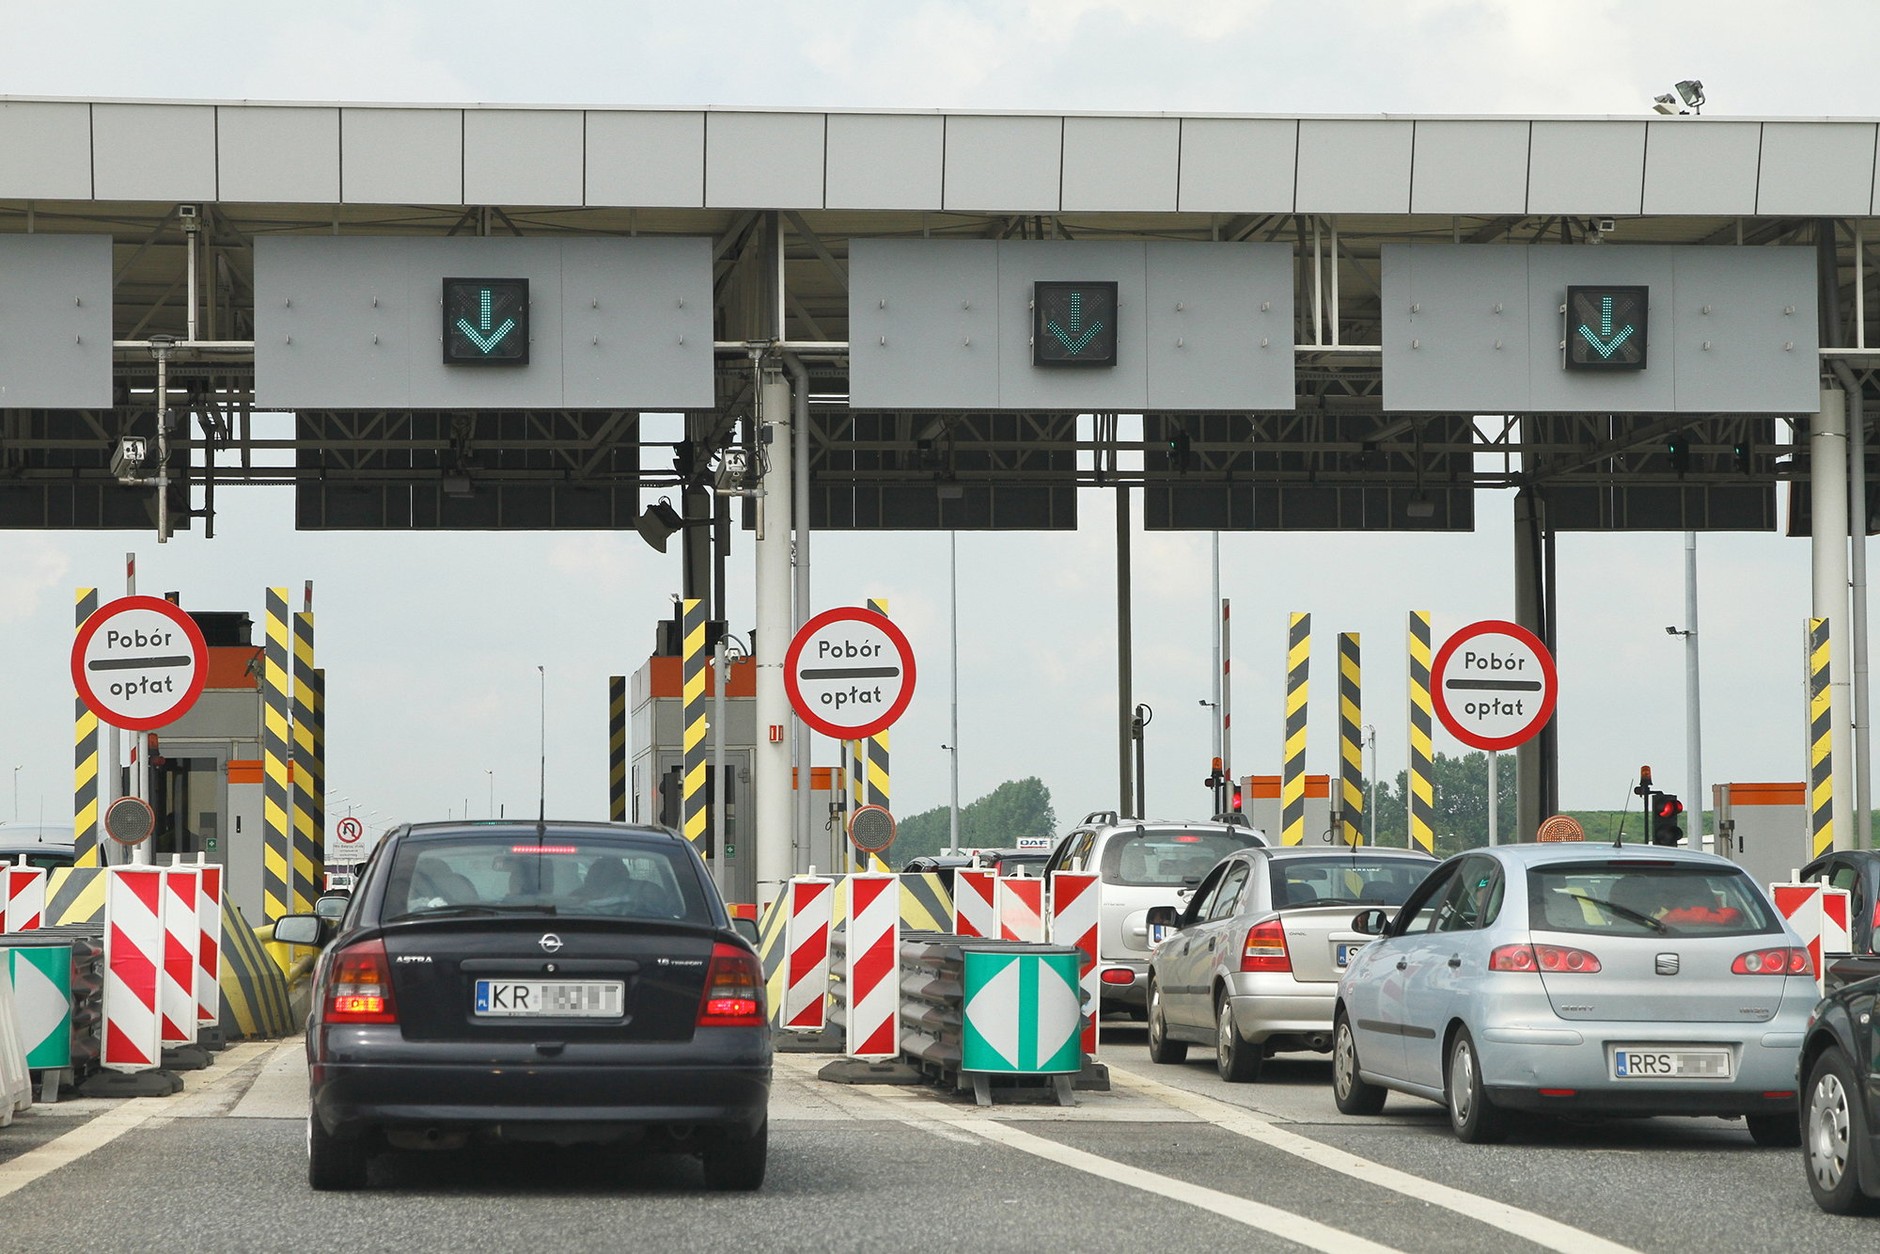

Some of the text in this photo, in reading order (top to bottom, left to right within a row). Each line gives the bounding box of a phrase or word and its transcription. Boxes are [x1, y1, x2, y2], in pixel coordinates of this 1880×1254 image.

[107, 628, 171, 649] Pobór
[819, 640, 881, 659] Pobór
[1465, 652, 1525, 670] Pobór
[110, 675, 173, 700] opłat
[820, 686, 882, 710] opłat
[1465, 698, 1523, 720] opłat
[396, 955, 433, 964] ASTRA
[493, 985, 530, 1009] KR
[1629, 1054, 1671, 1073] RRS
